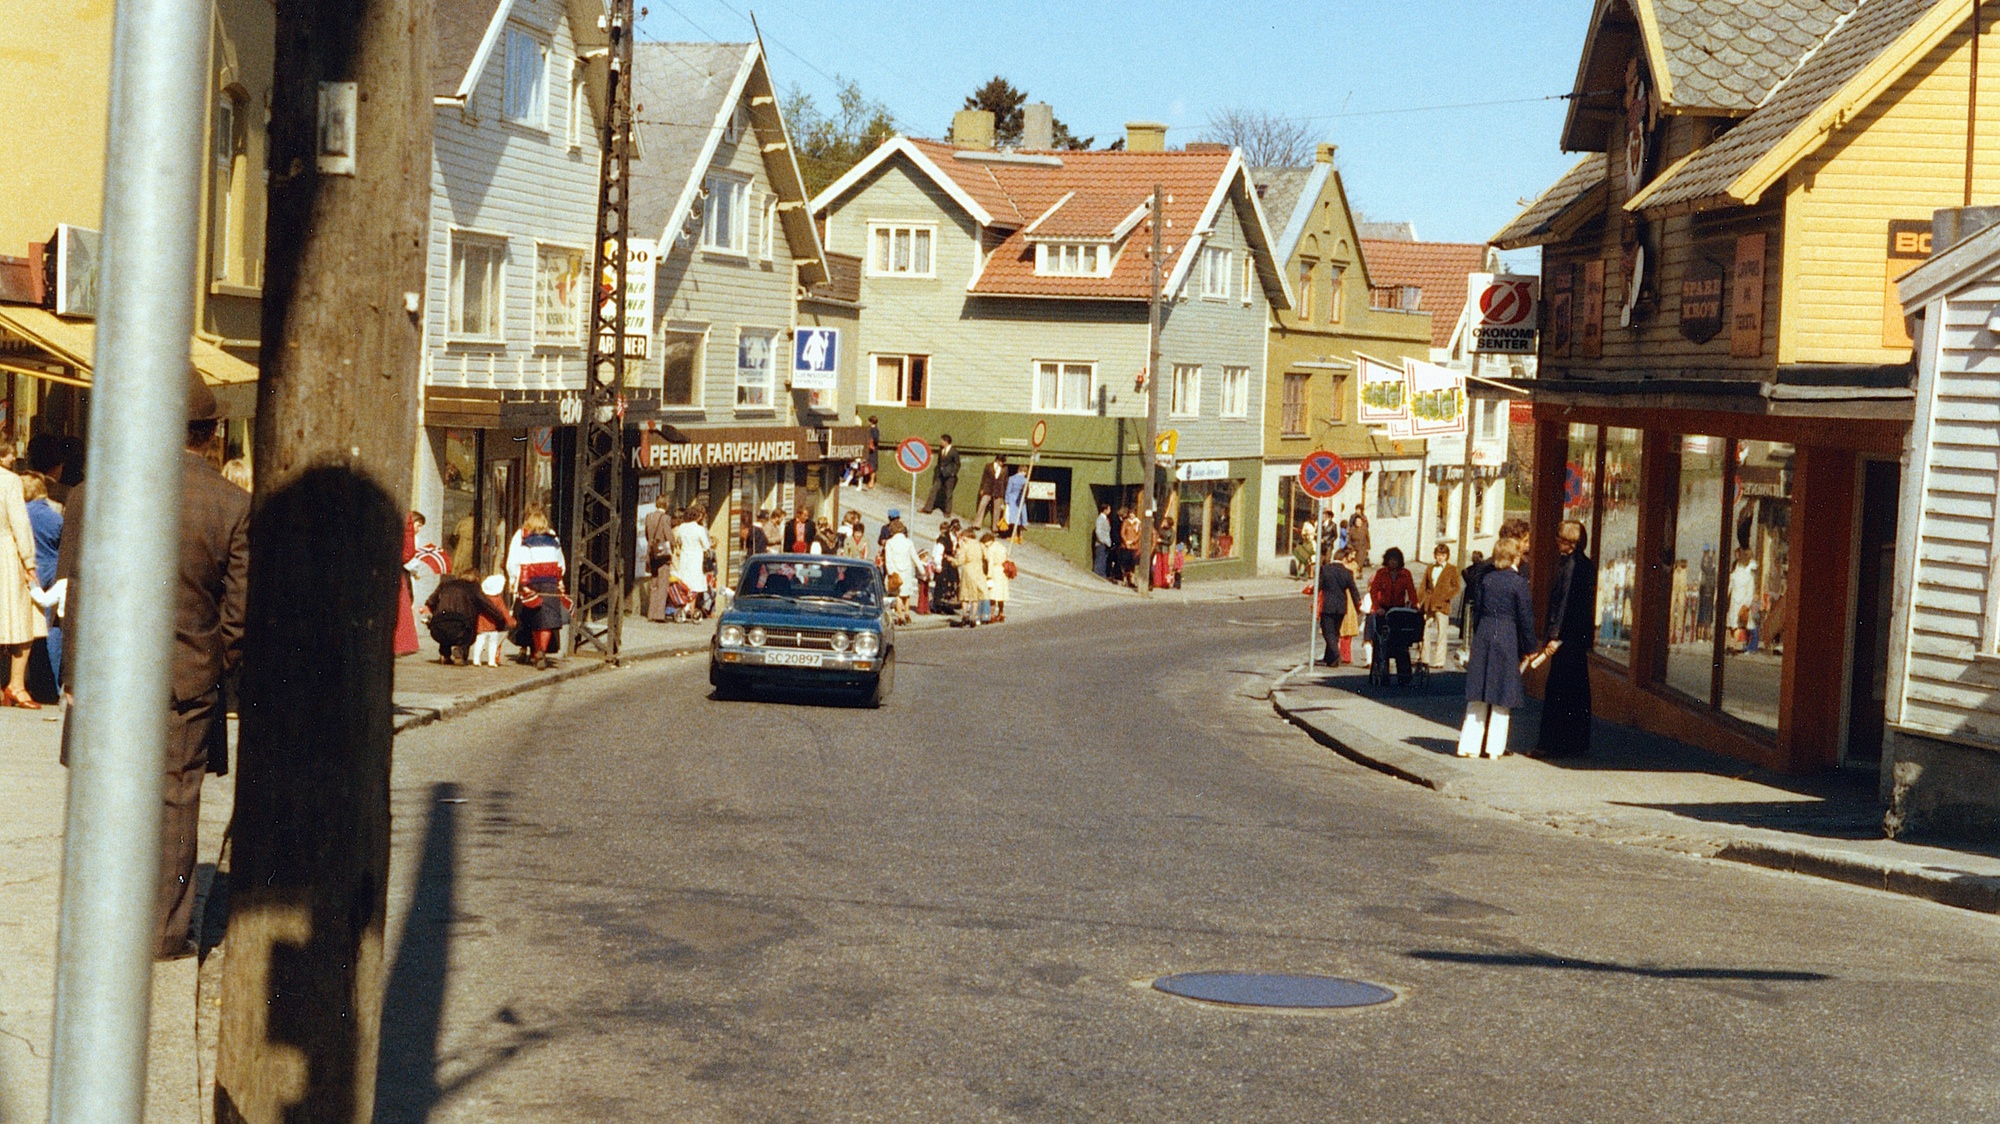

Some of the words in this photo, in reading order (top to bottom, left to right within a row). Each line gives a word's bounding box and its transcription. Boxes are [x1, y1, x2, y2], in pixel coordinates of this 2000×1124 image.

[1472, 327, 1535, 339] ØKONOMI
[1477, 338, 1529, 350] SENTER
[631, 443, 703, 469] KPERVIK
[706, 440, 799, 465] FARVEHANDEL
[767, 653, 782, 663] SC
[784, 653, 820, 664] 20897
